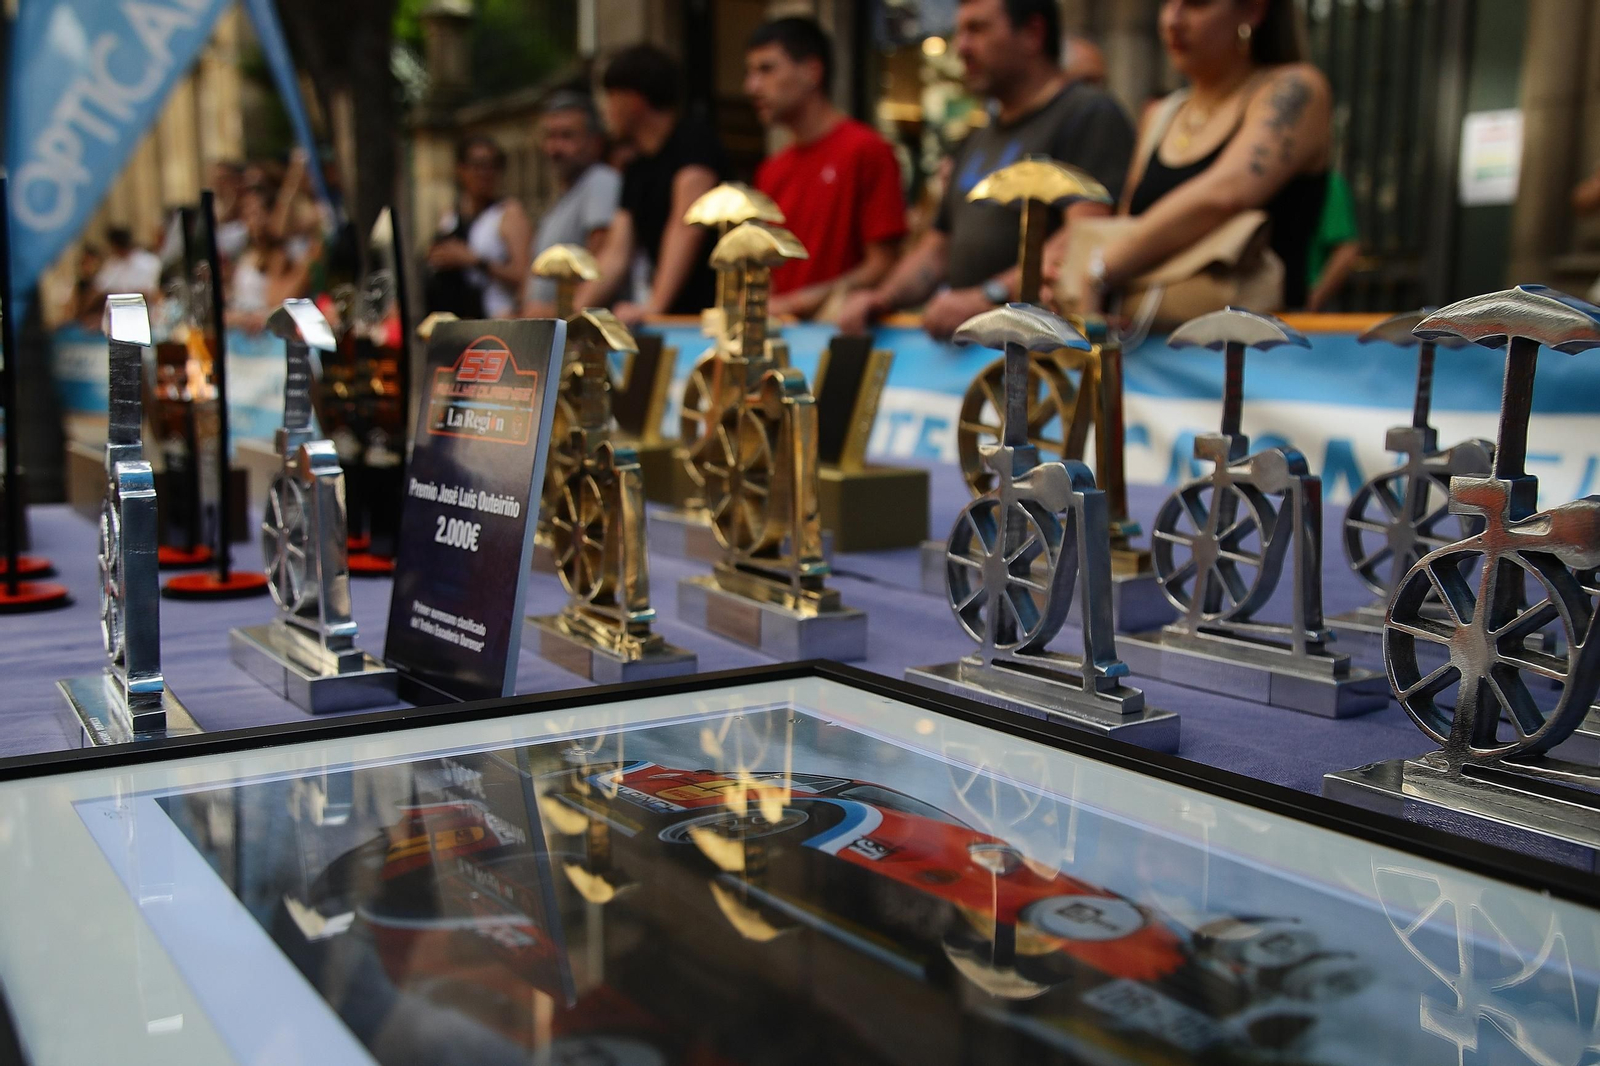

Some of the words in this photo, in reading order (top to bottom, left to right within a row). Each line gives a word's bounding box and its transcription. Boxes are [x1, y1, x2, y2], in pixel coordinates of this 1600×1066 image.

[11, 0, 212, 233] OPTICA
[456, 348, 510, 383] 59
[446, 407, 464, 428] La
[408, 477, 438, 501] Premio
[437, 483, 459, 506] José
[458, 487, 477, 510] Luis
[477, 491, 520, 519] Outeiriño
[434, 515, 482, 552] 2.000€
